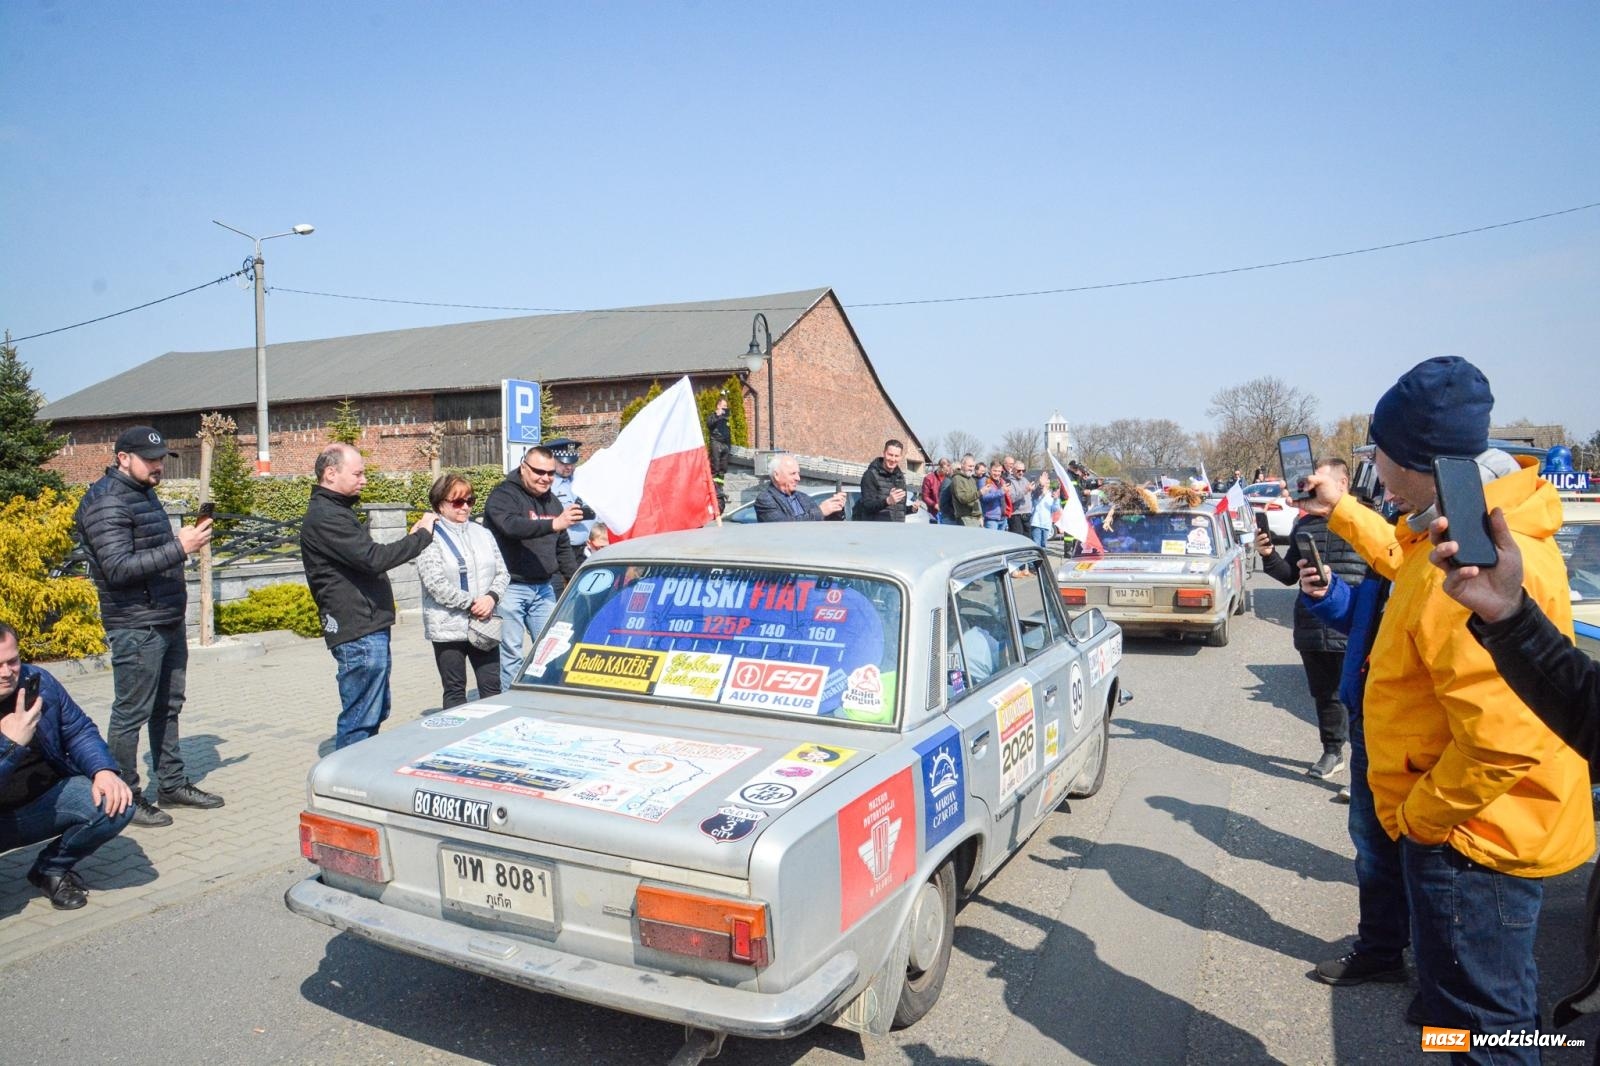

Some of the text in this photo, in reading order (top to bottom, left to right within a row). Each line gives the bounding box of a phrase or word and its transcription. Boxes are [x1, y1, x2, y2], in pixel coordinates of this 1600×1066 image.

[515, 386, 534, 424] P
[1540, 474, 1587, 489] ILICJA
[587, 572, 605, 592] T
[657, 577, 749, 609] POLSKI
[749, 580, 815, 612] FIAT
[814, 609, 847, 620] FSO
[626, 616, 836, 641] 80 100 125P 140 160
[575, 652, 604, 671] Radio
[764, 670, 820, 691] FSO
[729, 691, 769, 703] AUTO
[772, 695, 815, 709] KLUB
[1072, 678, 1083, 716] 99
[1003, 724, 1034, 775] 2026
[432, 796, 461, 822] 8081
[464, 801, 488, 826] PKT
[711, 828, 734, 839] CITY
[720, 820, 737, 832] 3
[496, 863, 547, 897] 8081
